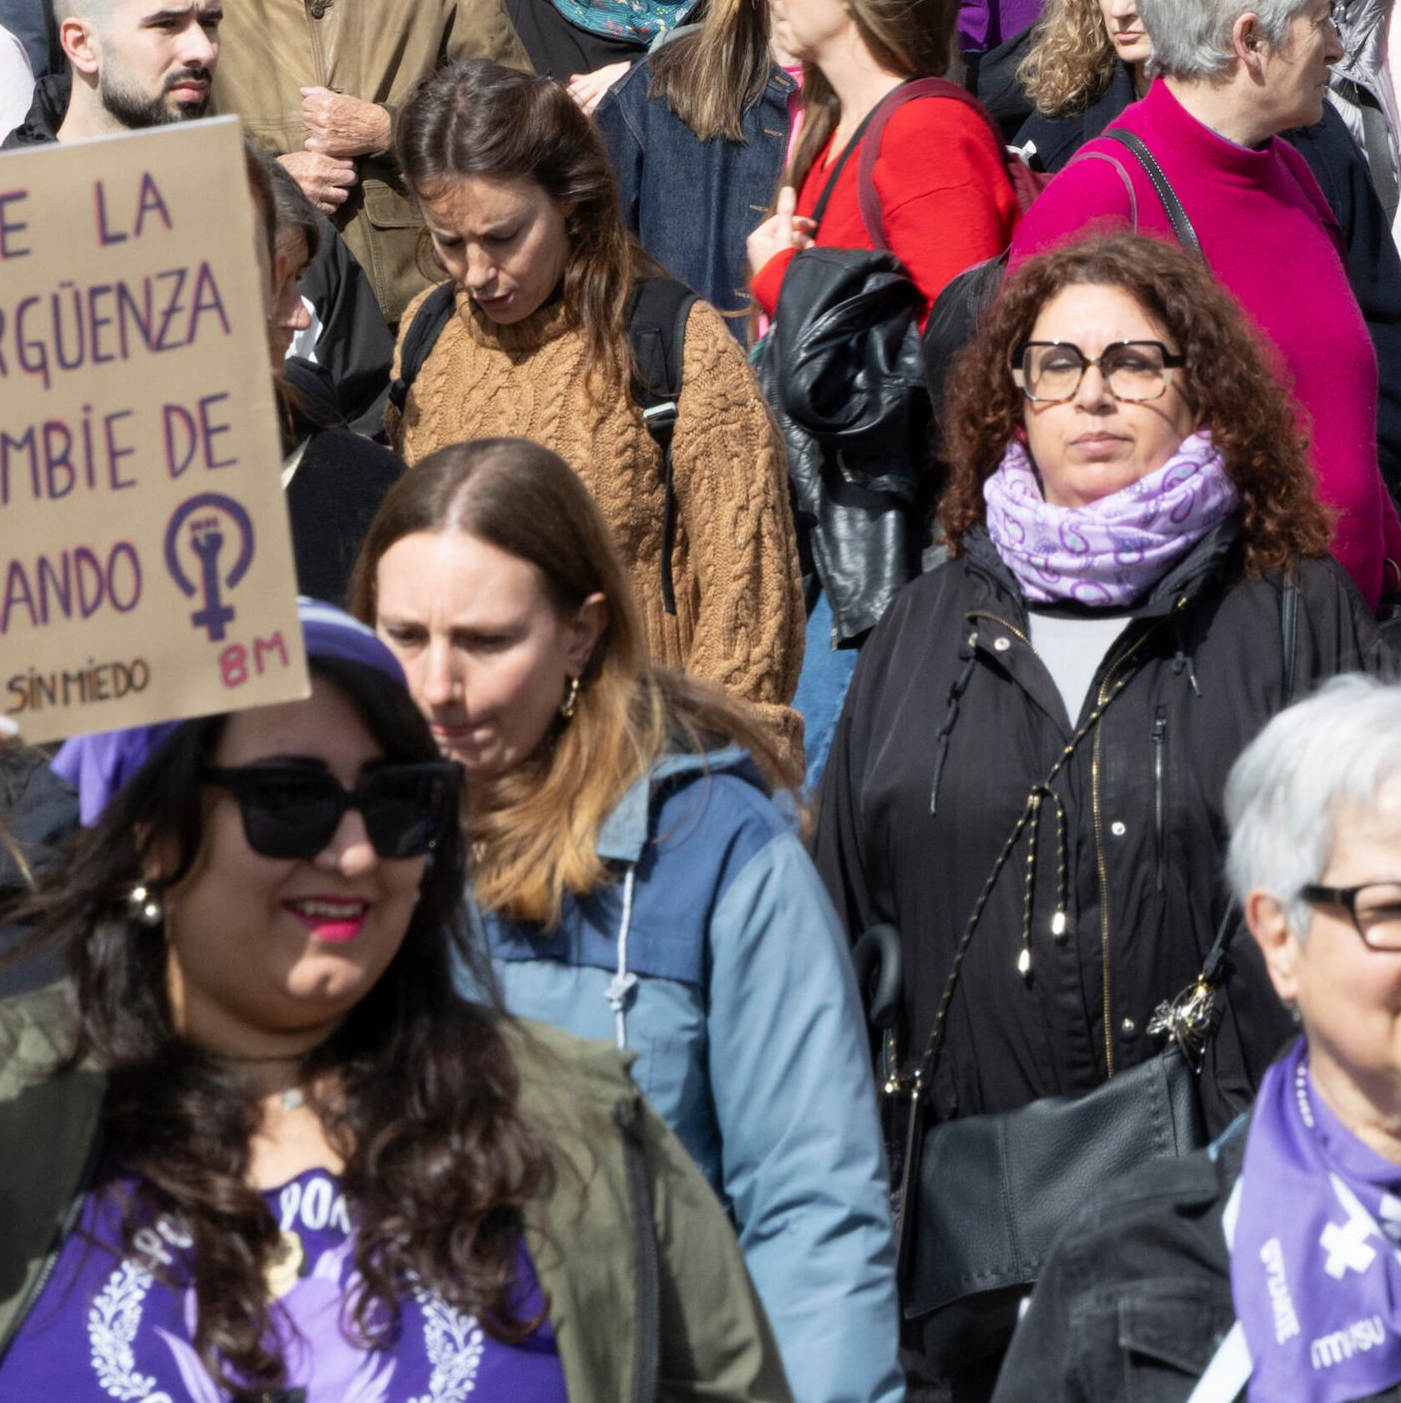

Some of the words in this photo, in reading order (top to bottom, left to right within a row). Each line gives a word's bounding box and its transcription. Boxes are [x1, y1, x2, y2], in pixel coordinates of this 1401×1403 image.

[94, 172, 173, 248] LA
[162, 392, 238, 482] DE
[218, 632, 290, 690] 8M
